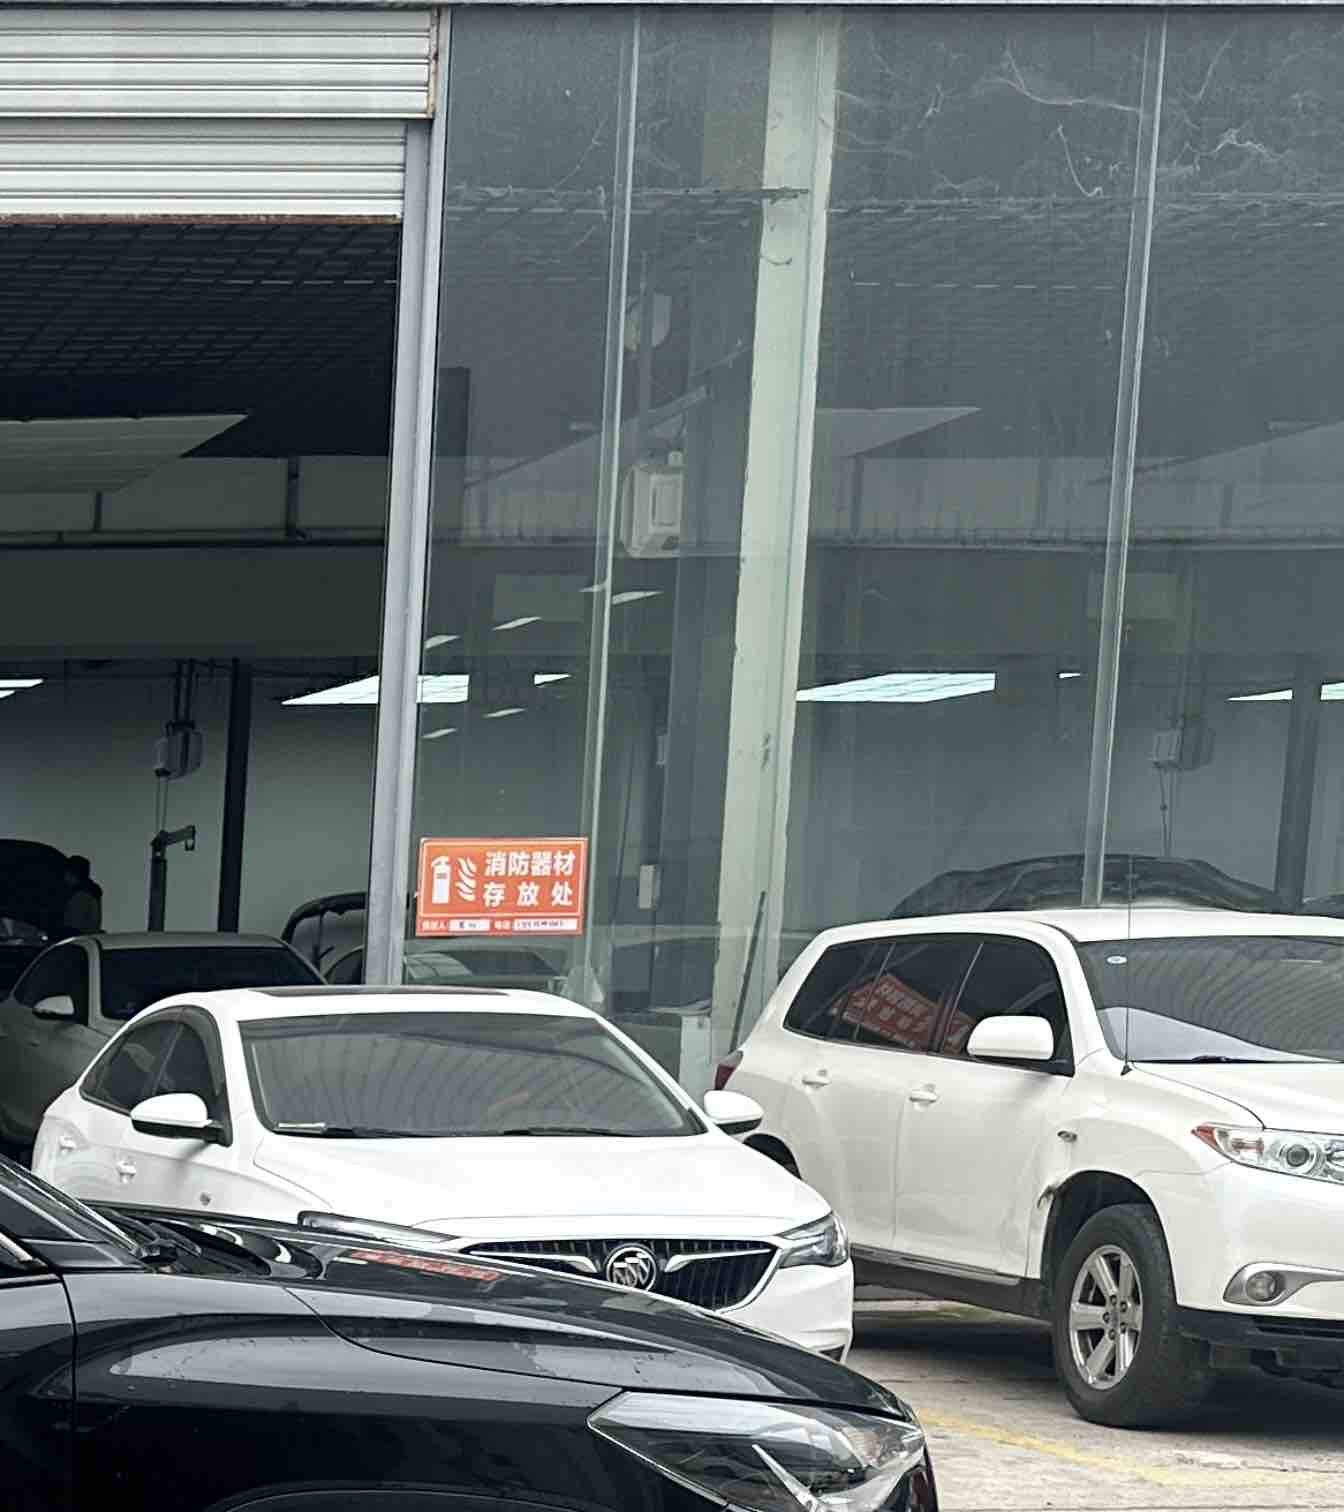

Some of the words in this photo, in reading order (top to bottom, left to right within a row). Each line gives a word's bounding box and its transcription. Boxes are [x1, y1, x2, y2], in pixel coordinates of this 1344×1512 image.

[484, 851, 576, 877] 消防器材
[483, 881, 573, 907] 存放处
